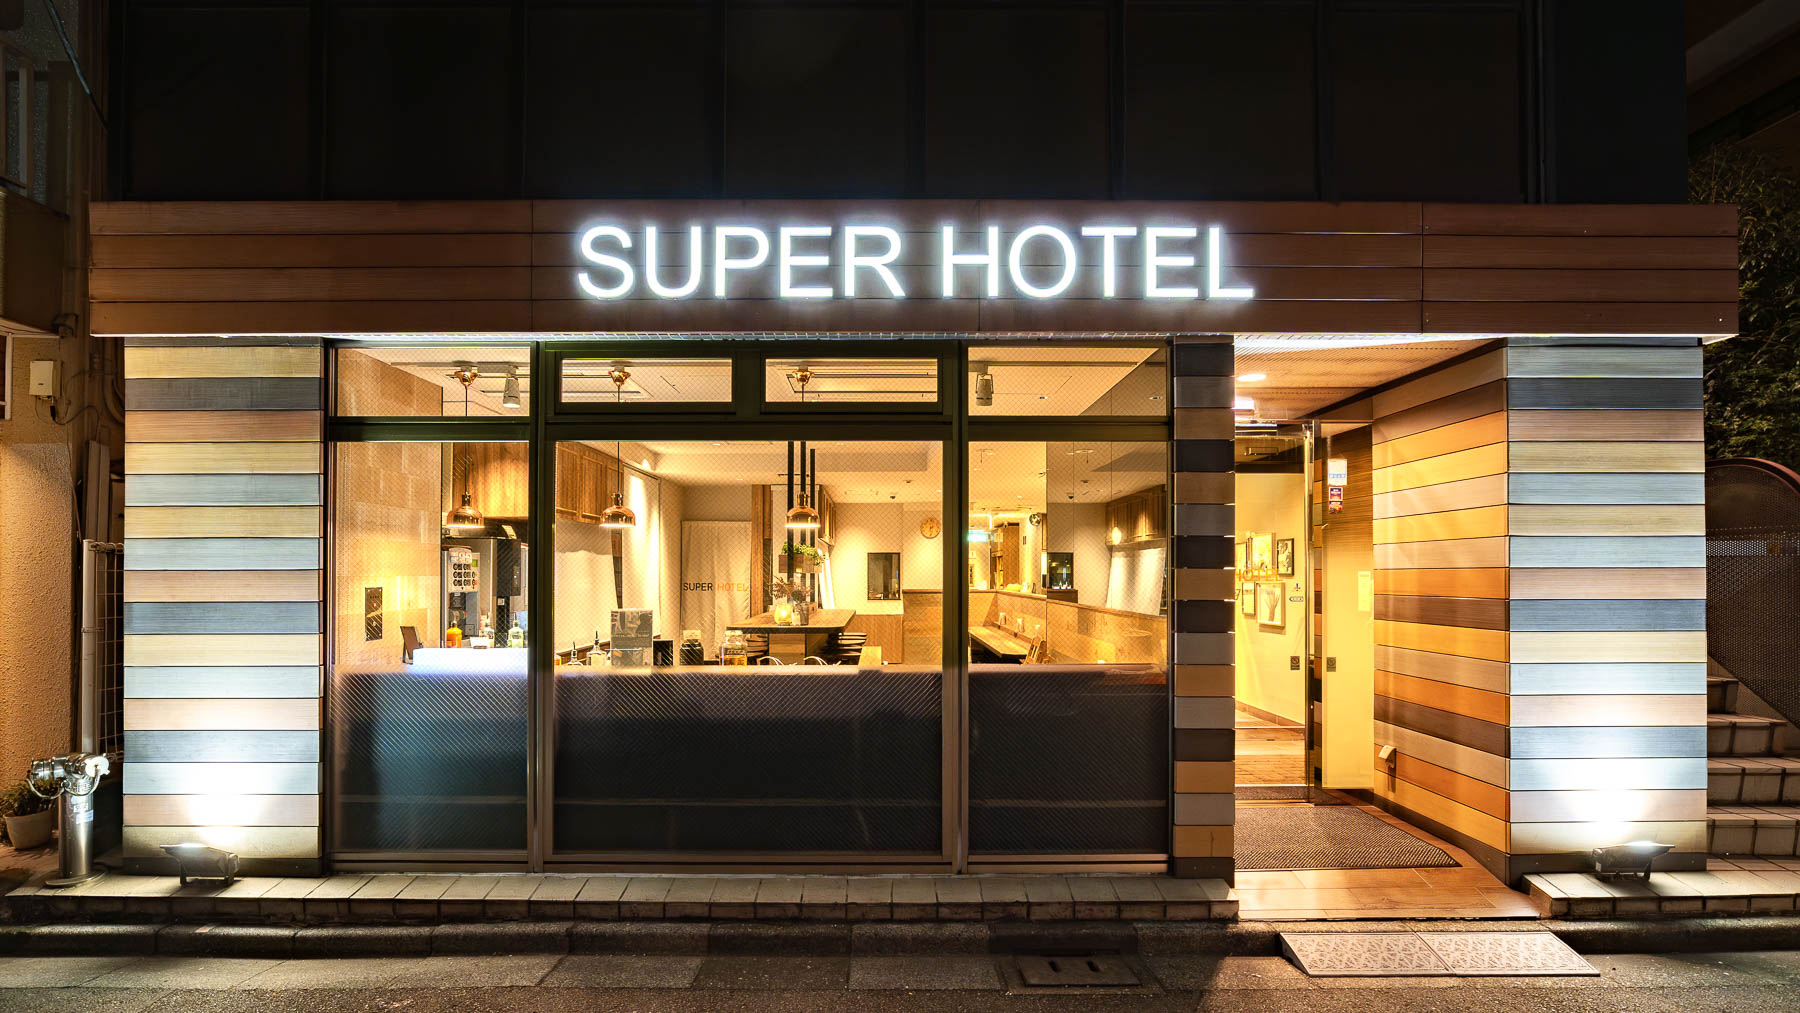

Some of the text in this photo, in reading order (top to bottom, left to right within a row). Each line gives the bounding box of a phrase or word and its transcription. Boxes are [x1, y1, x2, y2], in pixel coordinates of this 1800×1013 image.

[577, 225, 1255, 299] SUPER HOTEL
[683, 582, 749, 592] SUPER HOTEL
